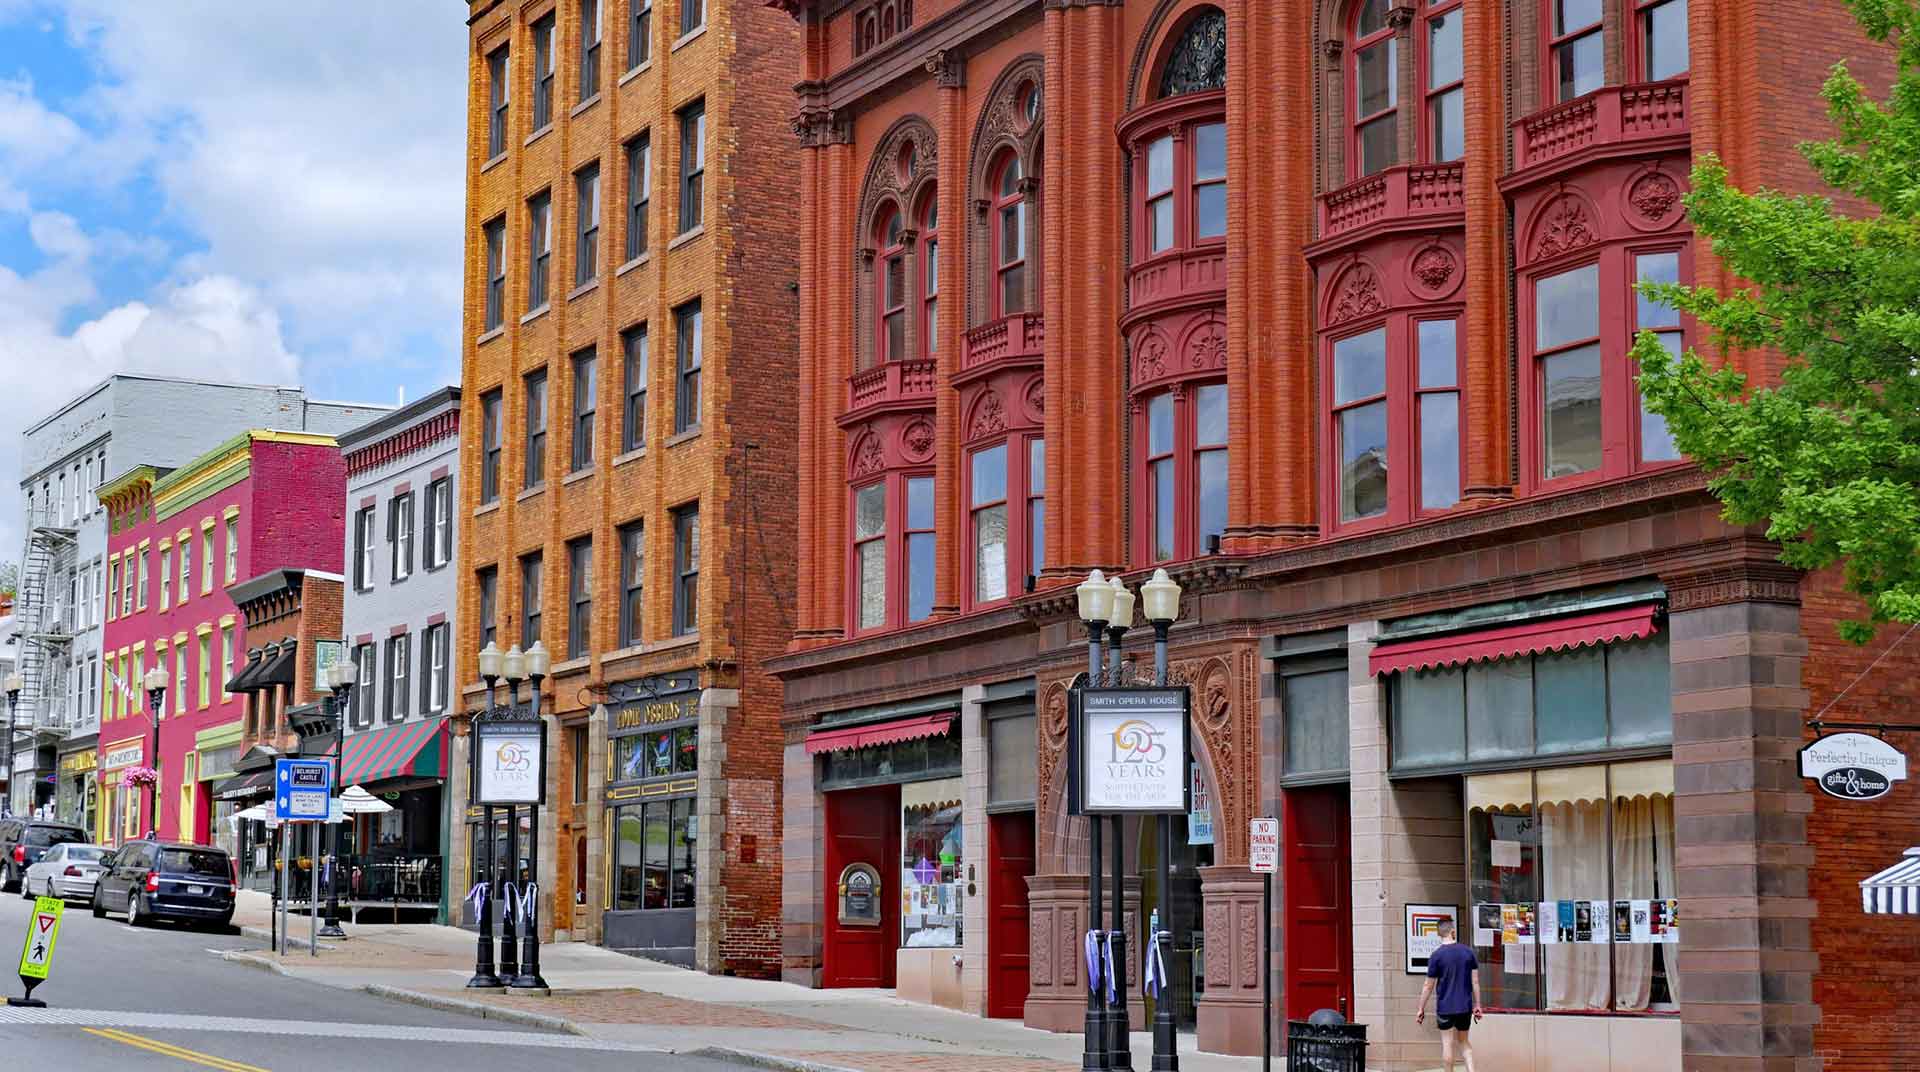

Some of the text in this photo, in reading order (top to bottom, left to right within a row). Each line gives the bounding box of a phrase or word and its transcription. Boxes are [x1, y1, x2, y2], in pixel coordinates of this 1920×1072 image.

[1089, 696, 1178, 705] SMITH OPERA HOUSE
[1105, 719, 1167, 764] 125
[1809, 750, 1898, 767] Perfectly Unique
[1104, 764, 1166, 778] YEARS
[1827, 769, 1885, 795] gifts & home
[1258, 822, 1269, 833] NO
[1251, 835, 1276, 844] PARKING
[1253, 845, 1275, 853] BETWEEN
